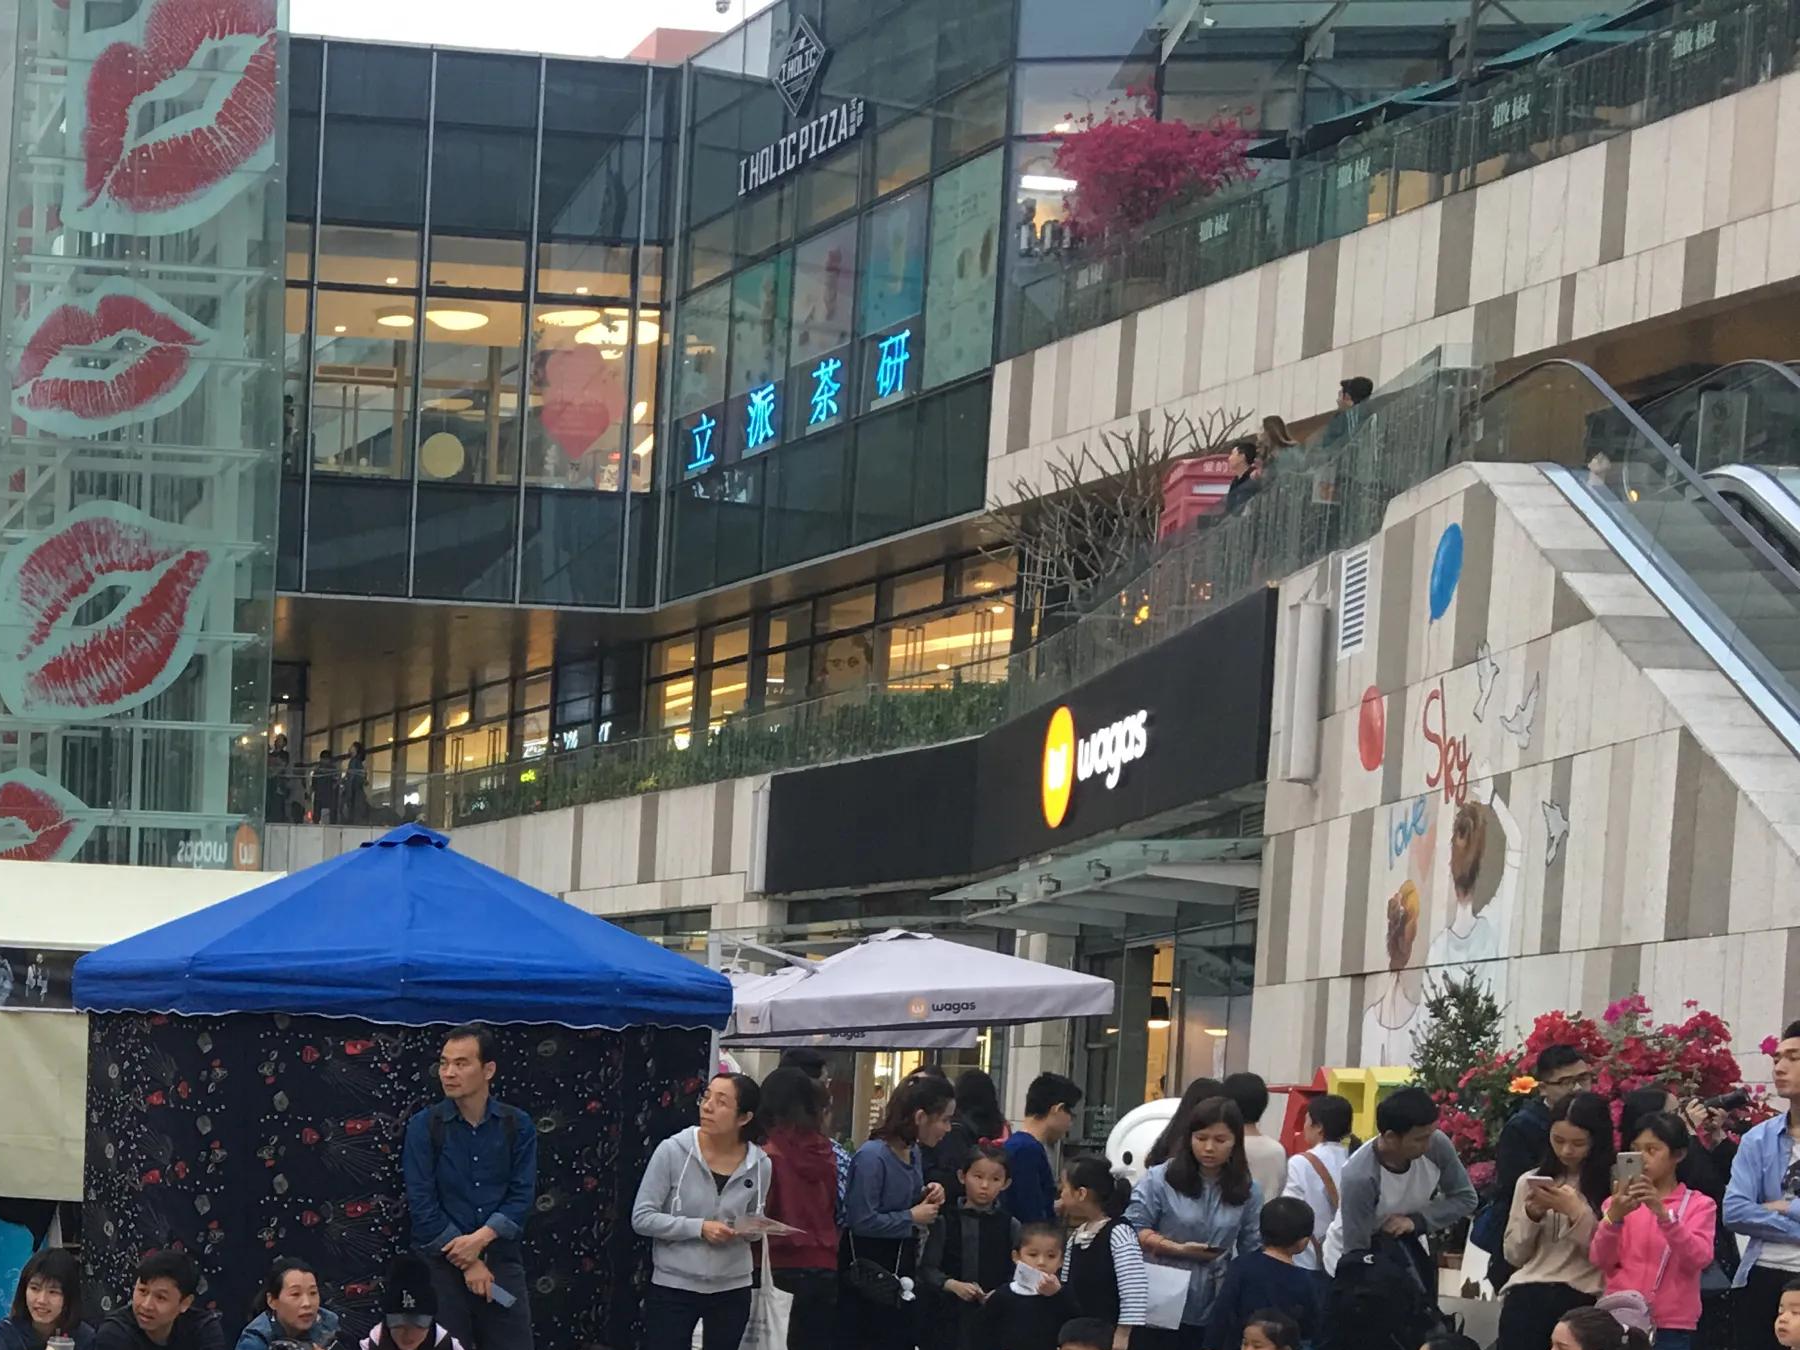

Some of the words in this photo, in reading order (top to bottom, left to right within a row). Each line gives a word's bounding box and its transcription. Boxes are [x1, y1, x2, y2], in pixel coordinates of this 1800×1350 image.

[748, 131, 797, 190] HOLIC
[798, 103, 848, 165] PIZZA
[687, 328, 911, 470] 立派茶研
[1077, 709, 1148, 790] wagas
[931, 1001, 977, 1014] wagas
